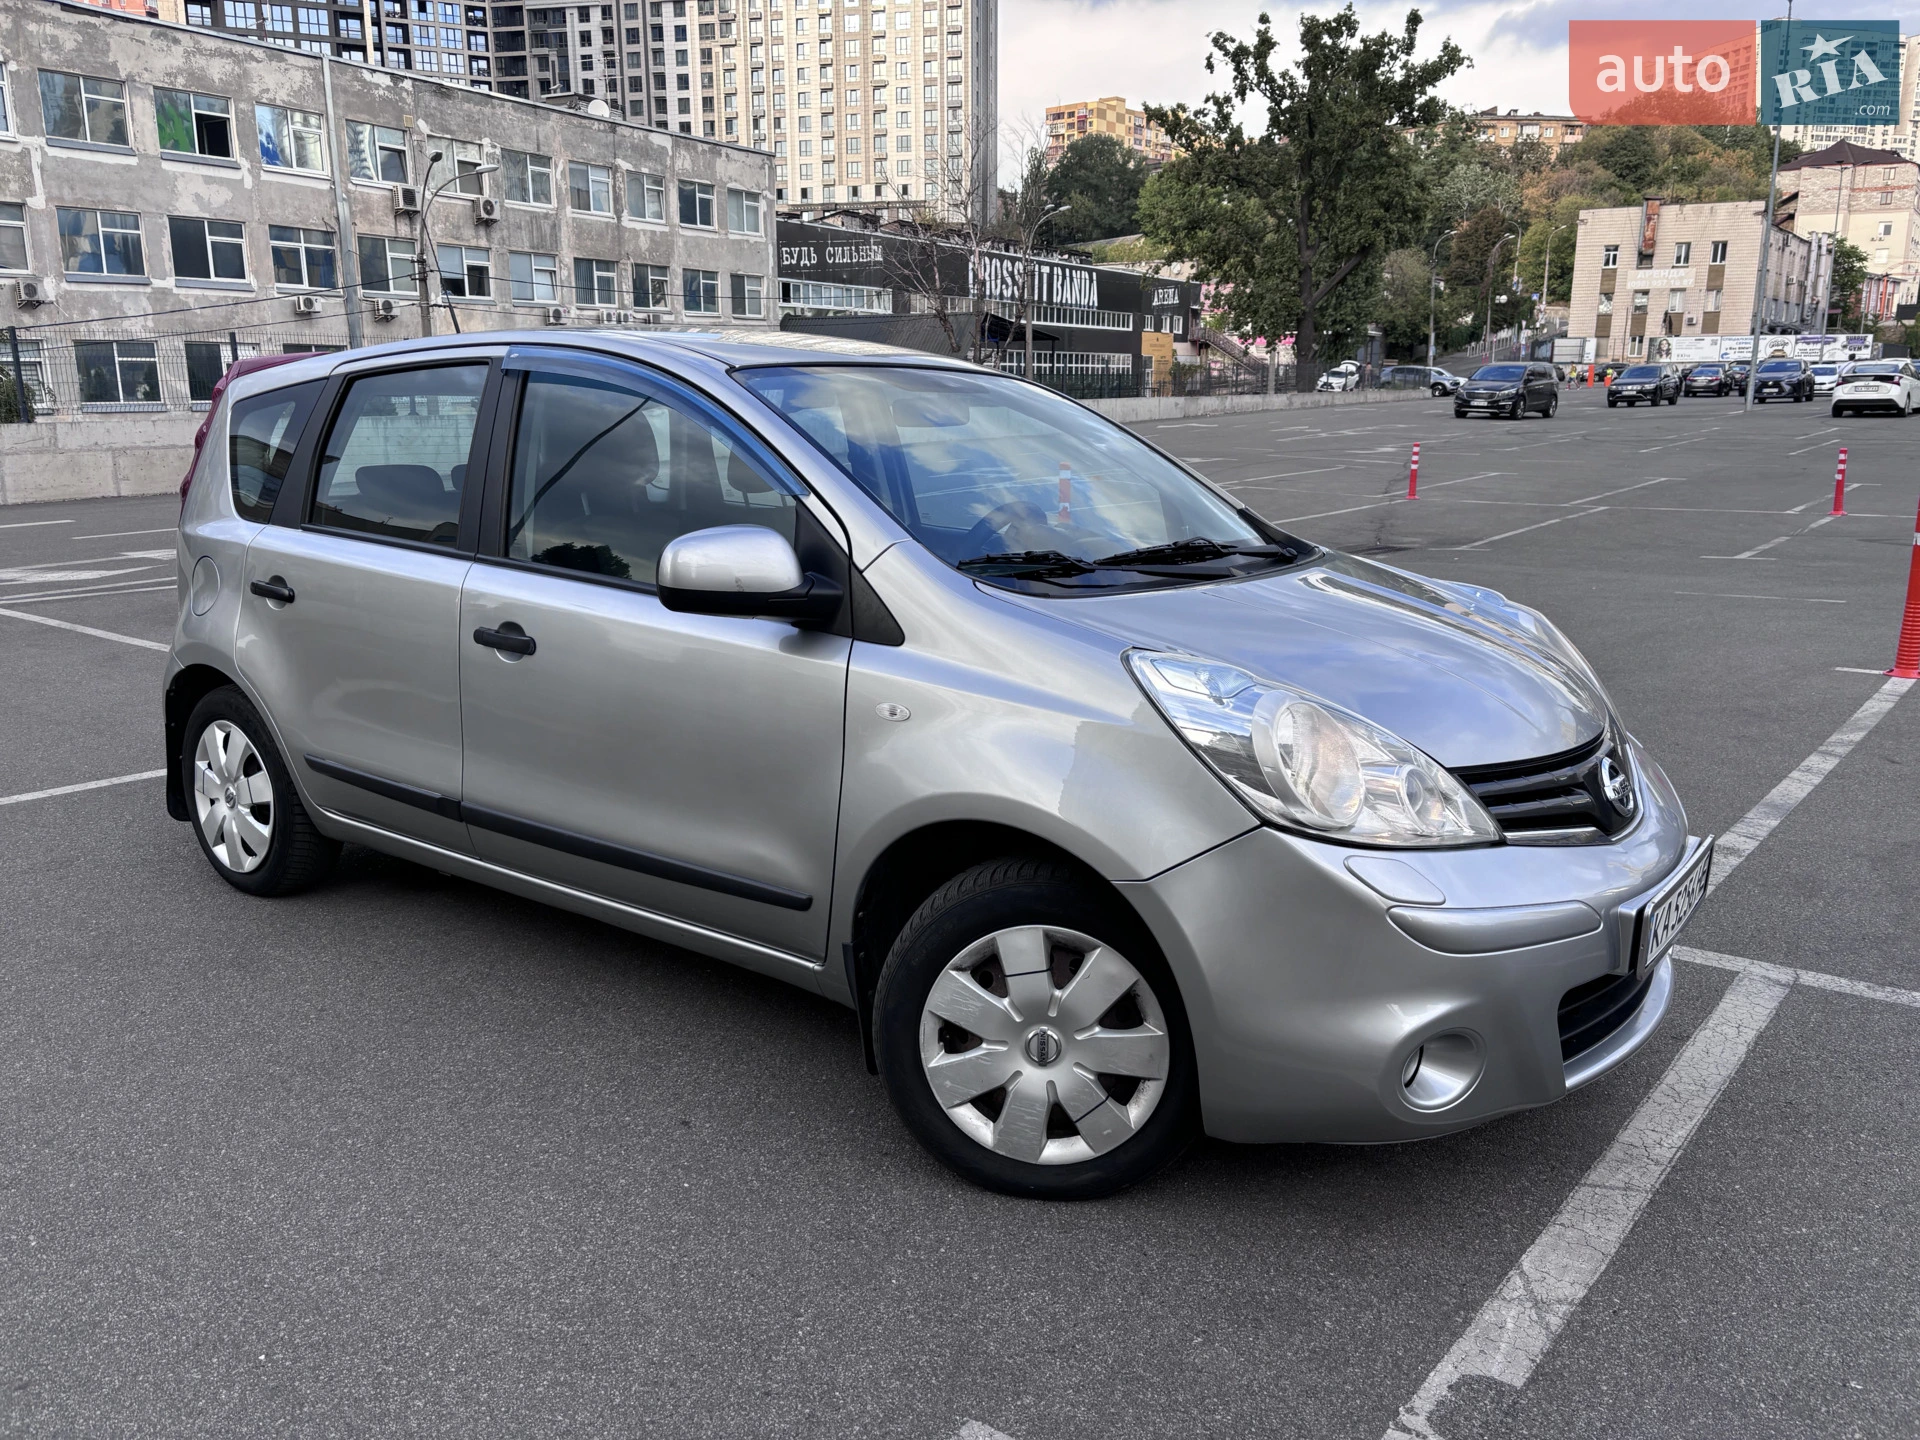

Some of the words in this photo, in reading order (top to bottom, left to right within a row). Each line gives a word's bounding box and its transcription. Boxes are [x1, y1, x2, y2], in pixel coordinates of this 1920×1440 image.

[781, 247, 818, 267] БУДЬ
[1637, 269, 1686, 280] АРЕНДА
[1053, 266, 1098, 308] BANDA
[1152, 288, 1179, 306] ARENA
